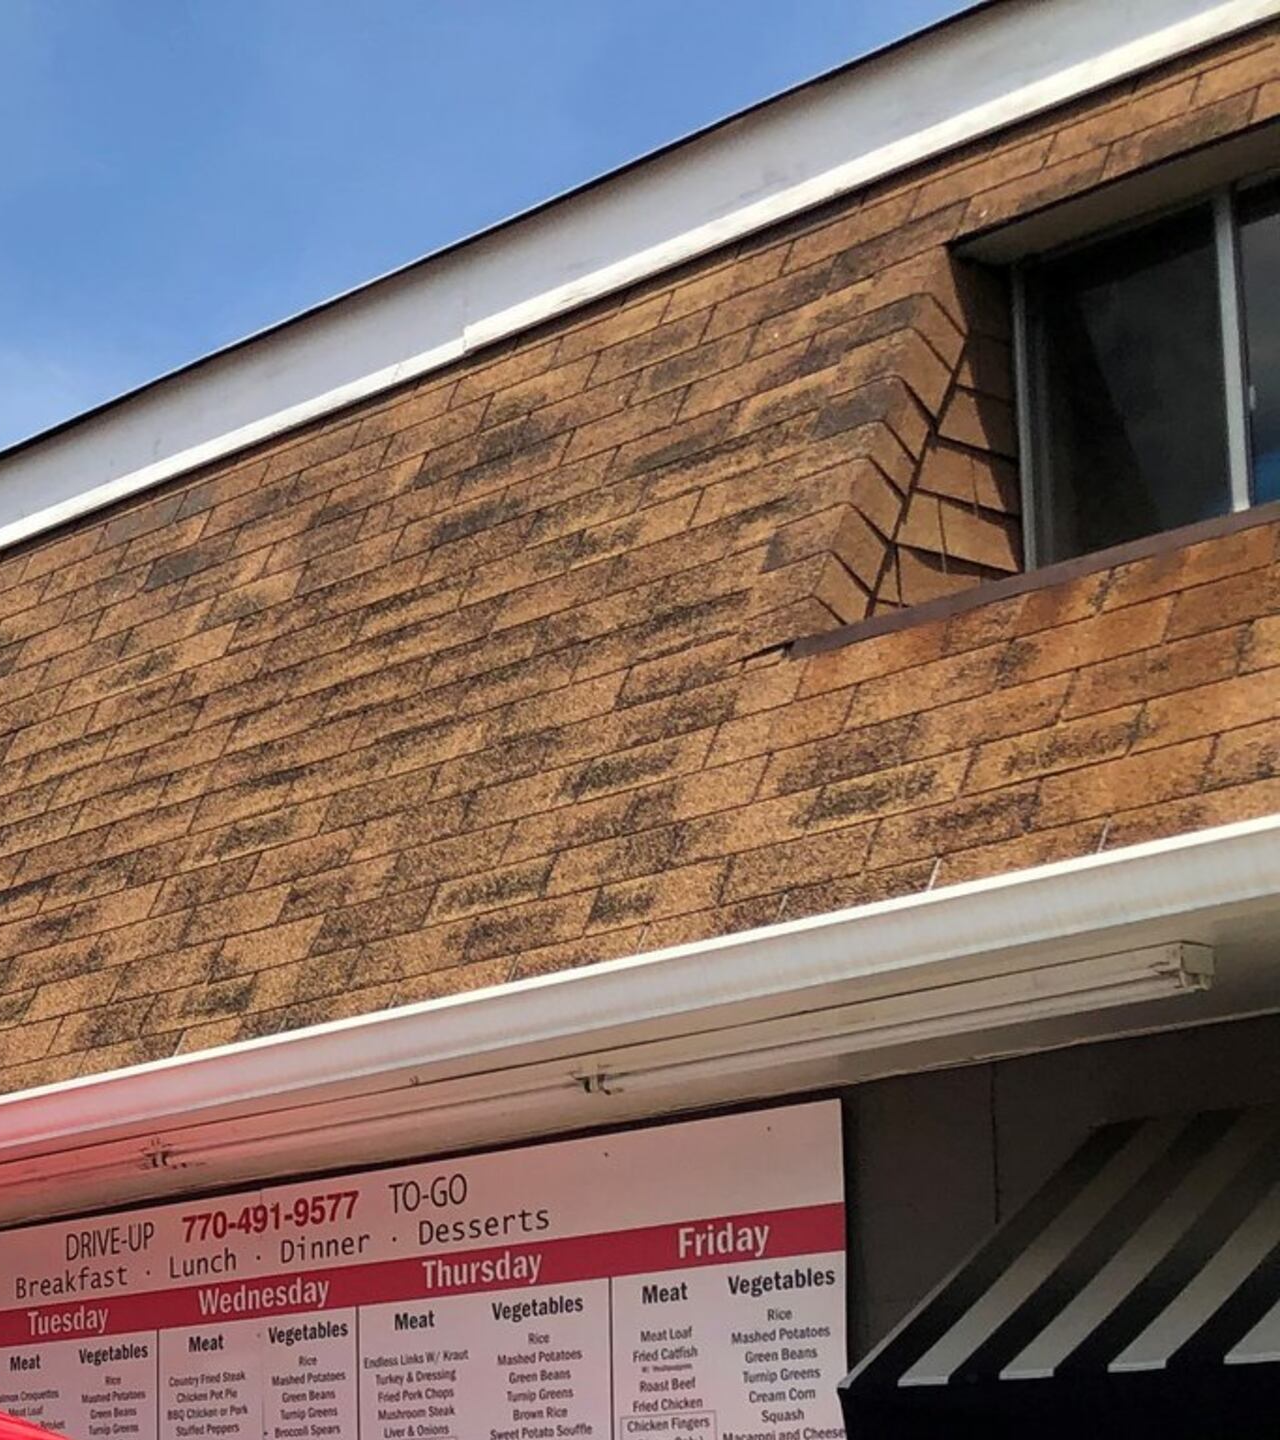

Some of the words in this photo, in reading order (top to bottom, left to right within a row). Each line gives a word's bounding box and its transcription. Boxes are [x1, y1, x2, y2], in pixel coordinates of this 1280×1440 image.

[65, 1221, 156, 1261] DRIVE-UP
[181, 1190, 360, 1243] 770-491-9577
[388, 1173, 468, 1214] TO-GO
[15, 1265, 128, 1299] Breakfast
[169, 1247, 237, 1280] Lunch
[280, 1230, 371, 1264] Dinner
[418, 1207, 550, 1246] Desserts
[27, 1306, 110, 1336] Tuesday
[198, 1277, 330, 1317] Wednesday
[421, 1249, 543, 1290] Thursday
[678, 1222, 770, 1259] Friday
[642, 1282, 689, 1305] Meat
[728, 1268, 836, 1298] Vegetables
[394, 1310, 436, 1331] Meat
[491, 1297, 584, 1323] Vegetables
[767, 1308, 792, 1322] Rice
[189, 1334, 224, 1352] Meat
[268, 1321, 349, 1346] Vegetables
[528, 1332, 550, 1344] Rice
[640, 1328, 667, 1343] Meat
[669, 1325, 693, 1340] Loaf
[731, 1329, 776, 1345] Mashed
[779, 1325, 831, 1341] Potatoes
[9, 1354, 41, 1372] Meat
[78, 1343, 149, 1367] Vegetables
[497, 1353, 536, 1366] Mashed
[538, 1349, 583, 1363] Potatoes
[632, 1348, 659, 1363] Fried
[661, 1345, 698, 1361] Catfish
[745, 1350, 779, 1364] Green
[781, 1346, 818, 1361] Beans
[375, 1373, 403, 1387] Turkey
[416, 1368, 456, 1382] Dressing
[639, 1379, 669, 1393] Roast
[671, 1377, 696, 1391] Beef
[743, 1370, 778, 1385] Turnip
[780, 1367, 821, 1381] Greens
[378, 1391, 400, 1403] Fried
[402, 1389, 423, 1401] Pork
[425, 1387, 454, 1400] Chops
[539, 1387, 574, 1401] Greens
[749, 1390, 786, 1404] Cream
[788, 1388, 816, 1402] Corn
[632, 1399, 659, 1413] Fried
[661, 1397, 703, 1412] Chicken
[627, 1417, 670, 1433] Chicken
[671, 1416, 711, 1431] Fingers
[761, 1409, 805, 1424] Squash
[490, 1428, 519, 1440] Sweet
[521, 1426, 554, 1439] Potato
[556, 1423, 592, 1437] Souffle
[778, 1428, 801, 1440] and
[803, 1425, 846, 1440] Cheese
